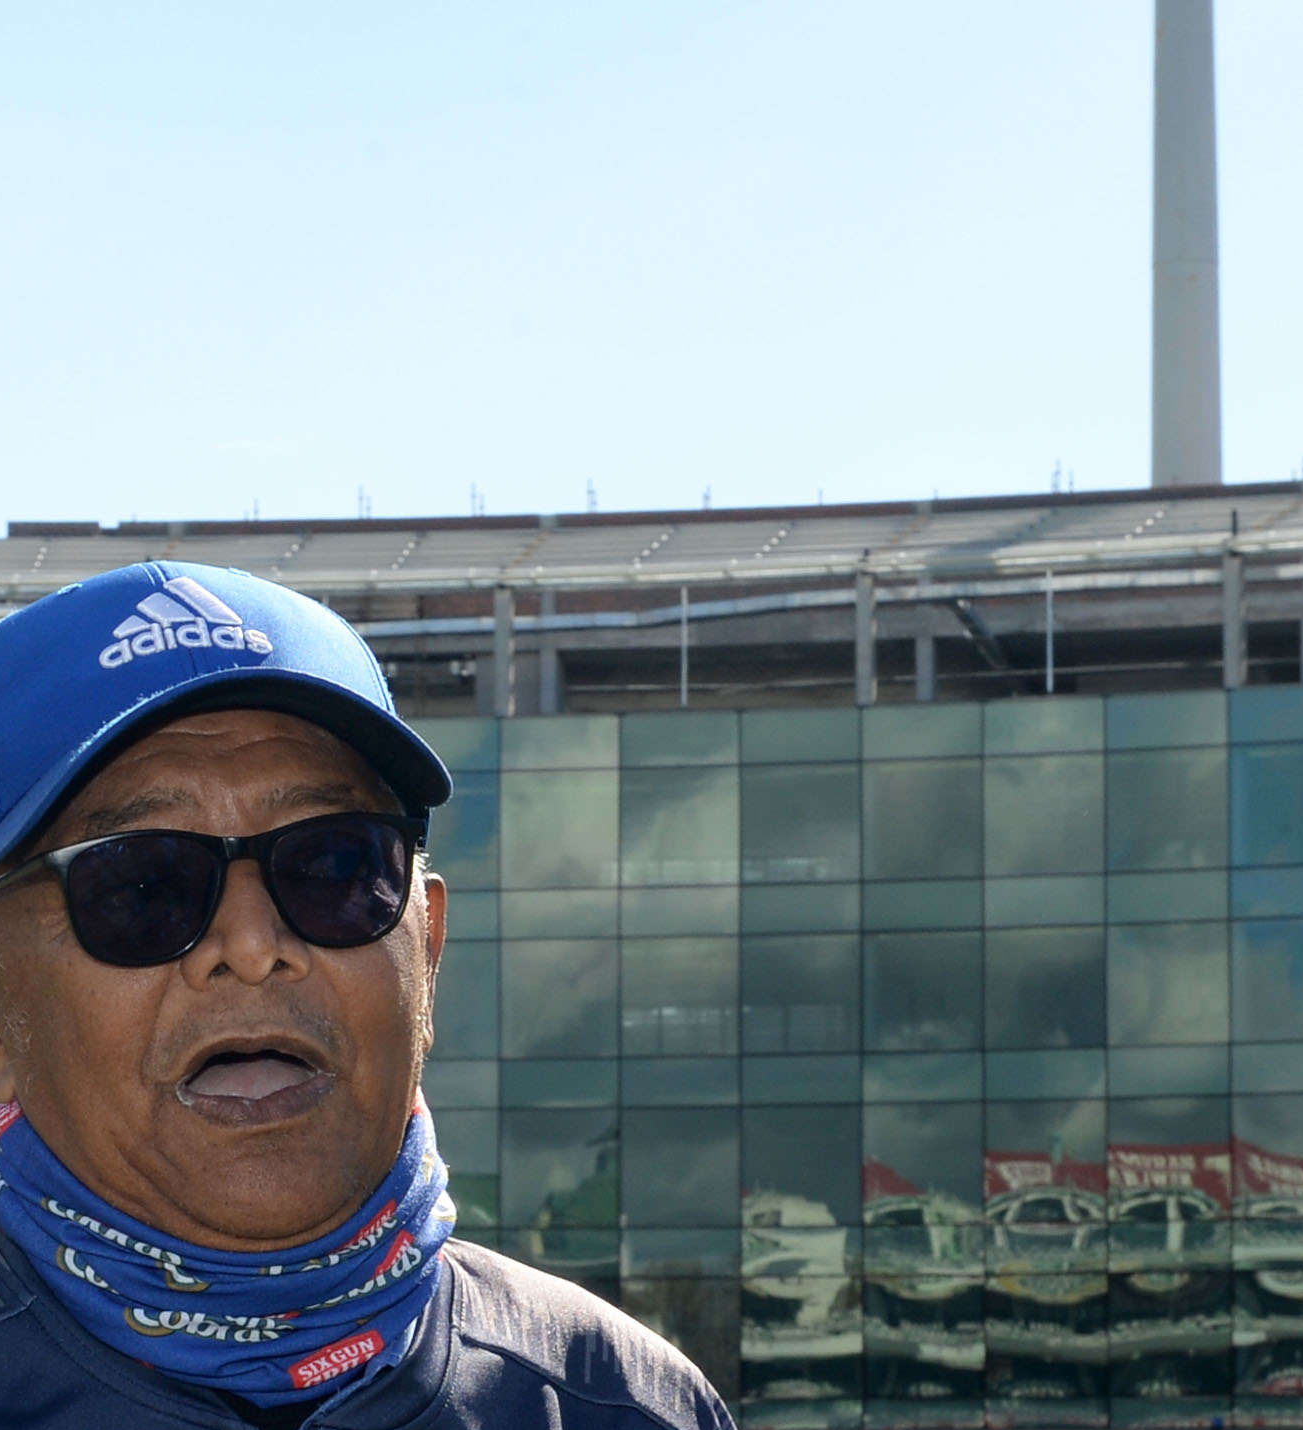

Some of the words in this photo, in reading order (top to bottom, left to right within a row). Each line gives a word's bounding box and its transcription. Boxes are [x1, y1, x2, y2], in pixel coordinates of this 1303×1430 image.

[99, 617, 273, 668] adidas
[298, 1356, 332, 1381] SIX
[330, 1338, 375, 1363] GUN
